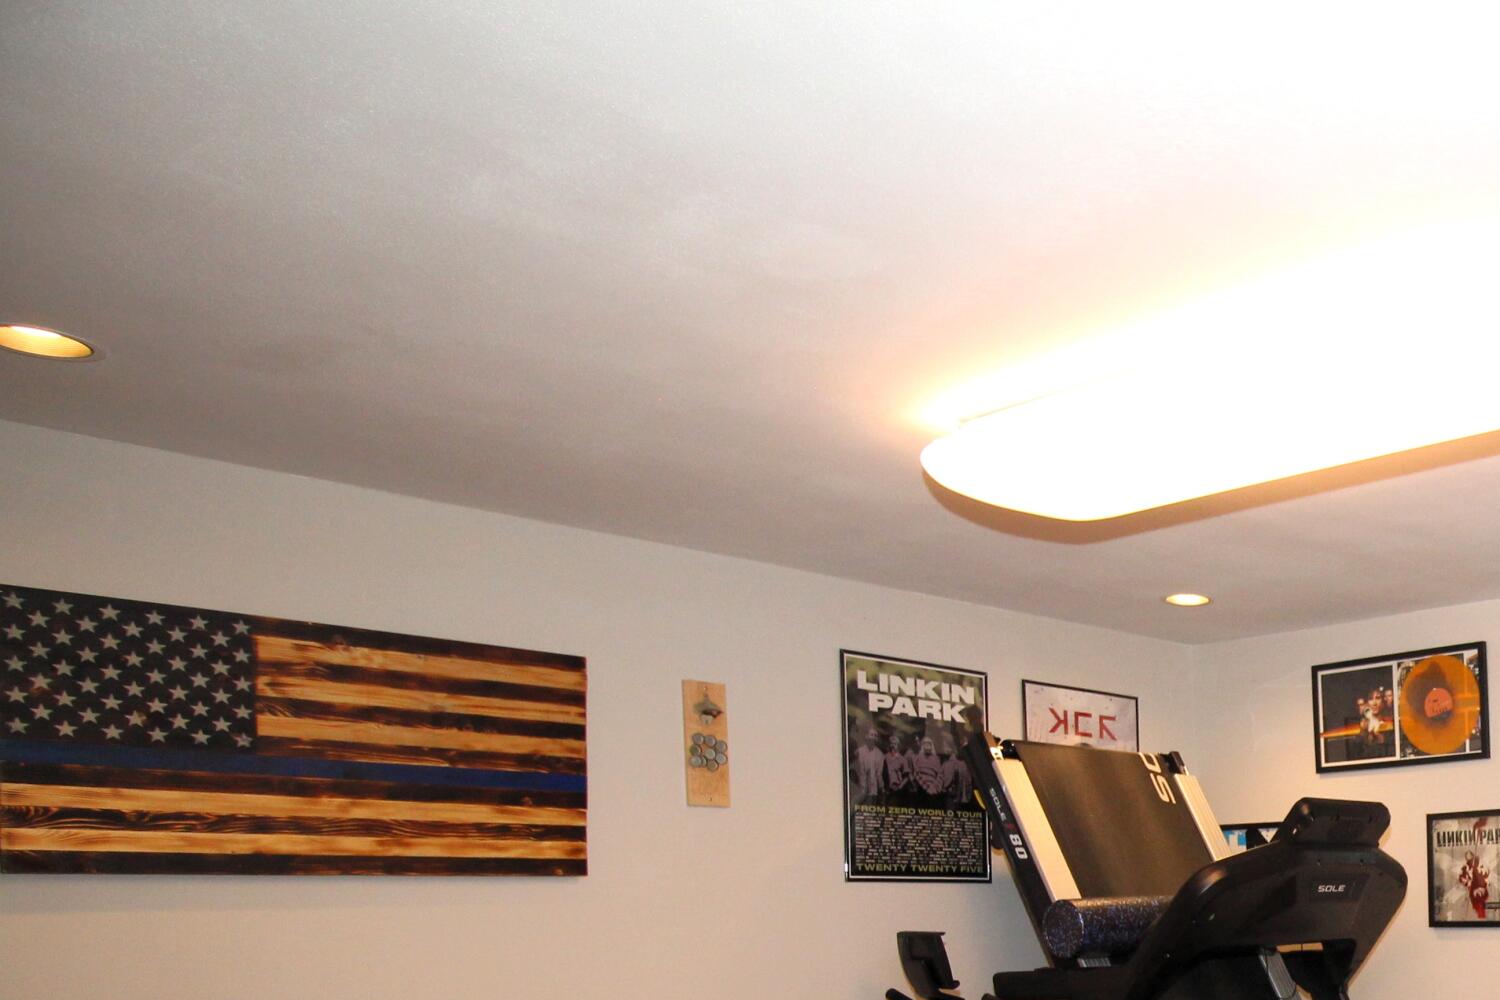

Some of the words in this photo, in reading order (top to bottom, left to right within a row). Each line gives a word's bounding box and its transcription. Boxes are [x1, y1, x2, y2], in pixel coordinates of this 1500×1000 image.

[857, 669, 975, 705] LINKIN
[868, 692, 966, 723] PARK
[854, 804, 886, 814] FROM
[888, 806, 916, 815] ZERO
[918, 808, 954, 817] WORLD
[956, 810, 982, 818] TOUR
[990, 788, 1007, 822] SOLE
[856, 863, 907, 872] TWENTY
[910, 864, 957, 873] TWENTY
[960, 865, 984, 873] FIVE
[1318, 884, 1346, 893] SOLE
